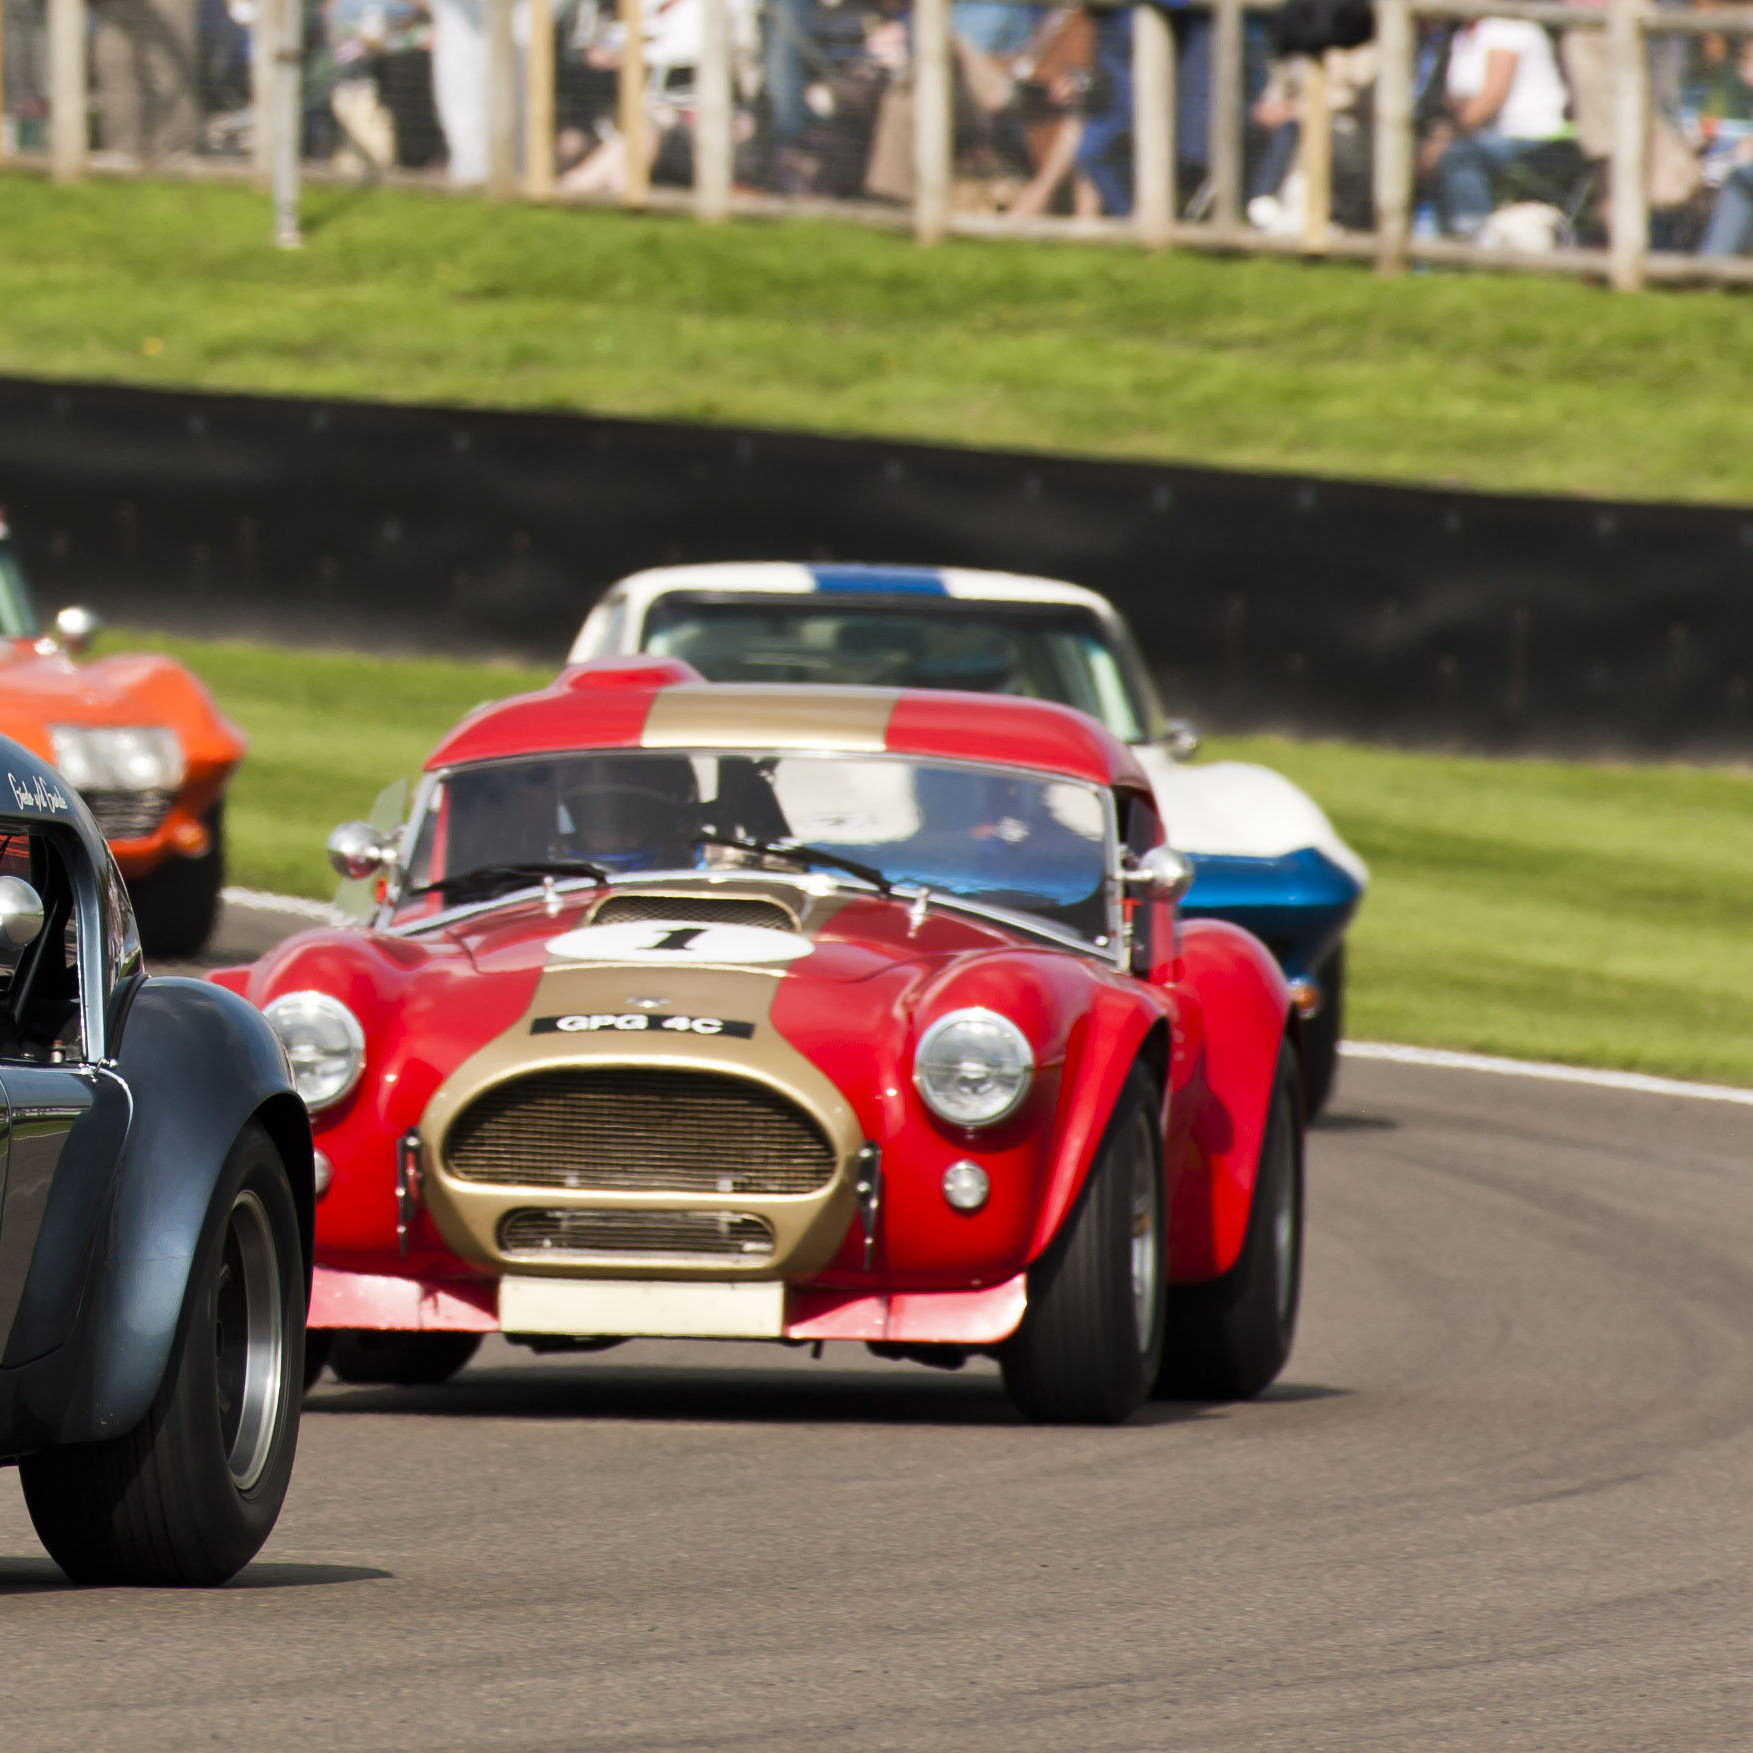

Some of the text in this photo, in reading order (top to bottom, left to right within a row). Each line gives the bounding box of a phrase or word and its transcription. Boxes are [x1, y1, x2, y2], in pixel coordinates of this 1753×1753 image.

[633, 928, 710, 951] 1
[556, 1013, 724, 1035] GPG 4C
